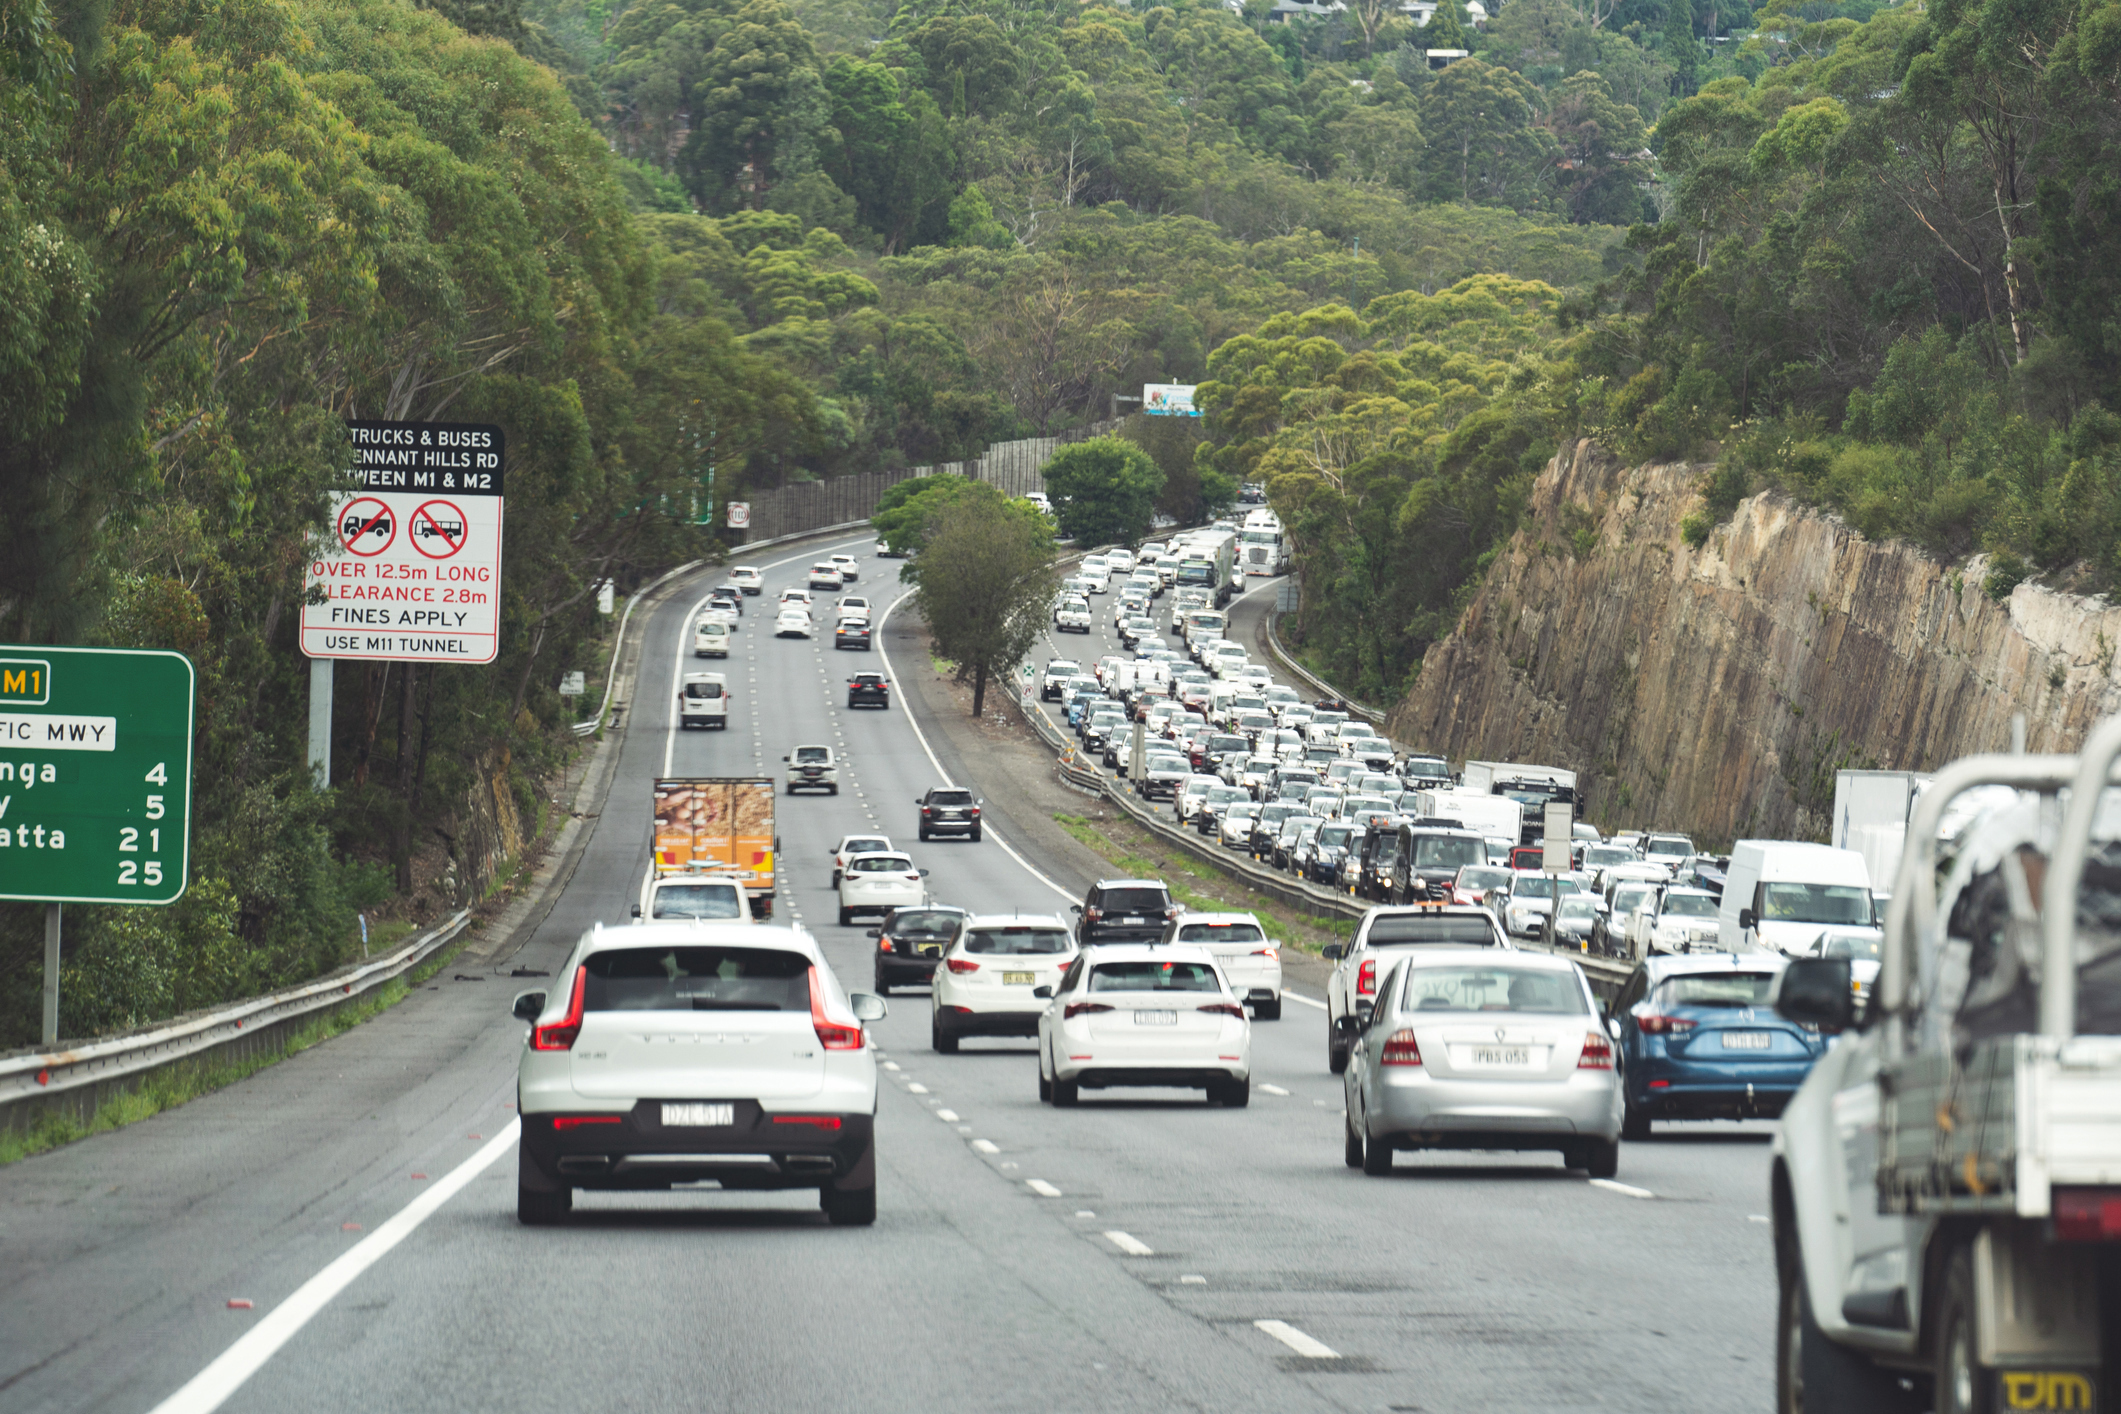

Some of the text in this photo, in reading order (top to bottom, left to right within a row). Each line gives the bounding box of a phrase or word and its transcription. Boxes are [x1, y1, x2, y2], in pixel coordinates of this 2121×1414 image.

[351, 428, 491, 447] TRUCKS & BUSES
[352, 449, 499, 468] ENNANT HILLS RD
[413, 472, 435, 487] M1
[443, 473, 455, 487] &
[463, 474, 491, 489] M2
[312, 561, 490, 582] OVER 12.5m LONG
[321, 584, 487, 604] LEARANCE 2.8m
[332, 607, 467, 627] FINES APPLY
[325, 636, 468, 653] USE M11 TUNNEL
[3, 669, 40, 695] M1
[48, 723, 106, 742] MWY
[0, 762, 168, 790] nga 4
[145, 795, 165, 819] 5
[0, 824, 65, 849] atta
[119, 827, 159, 852] 21
[118, 860, 163, 886] 25
